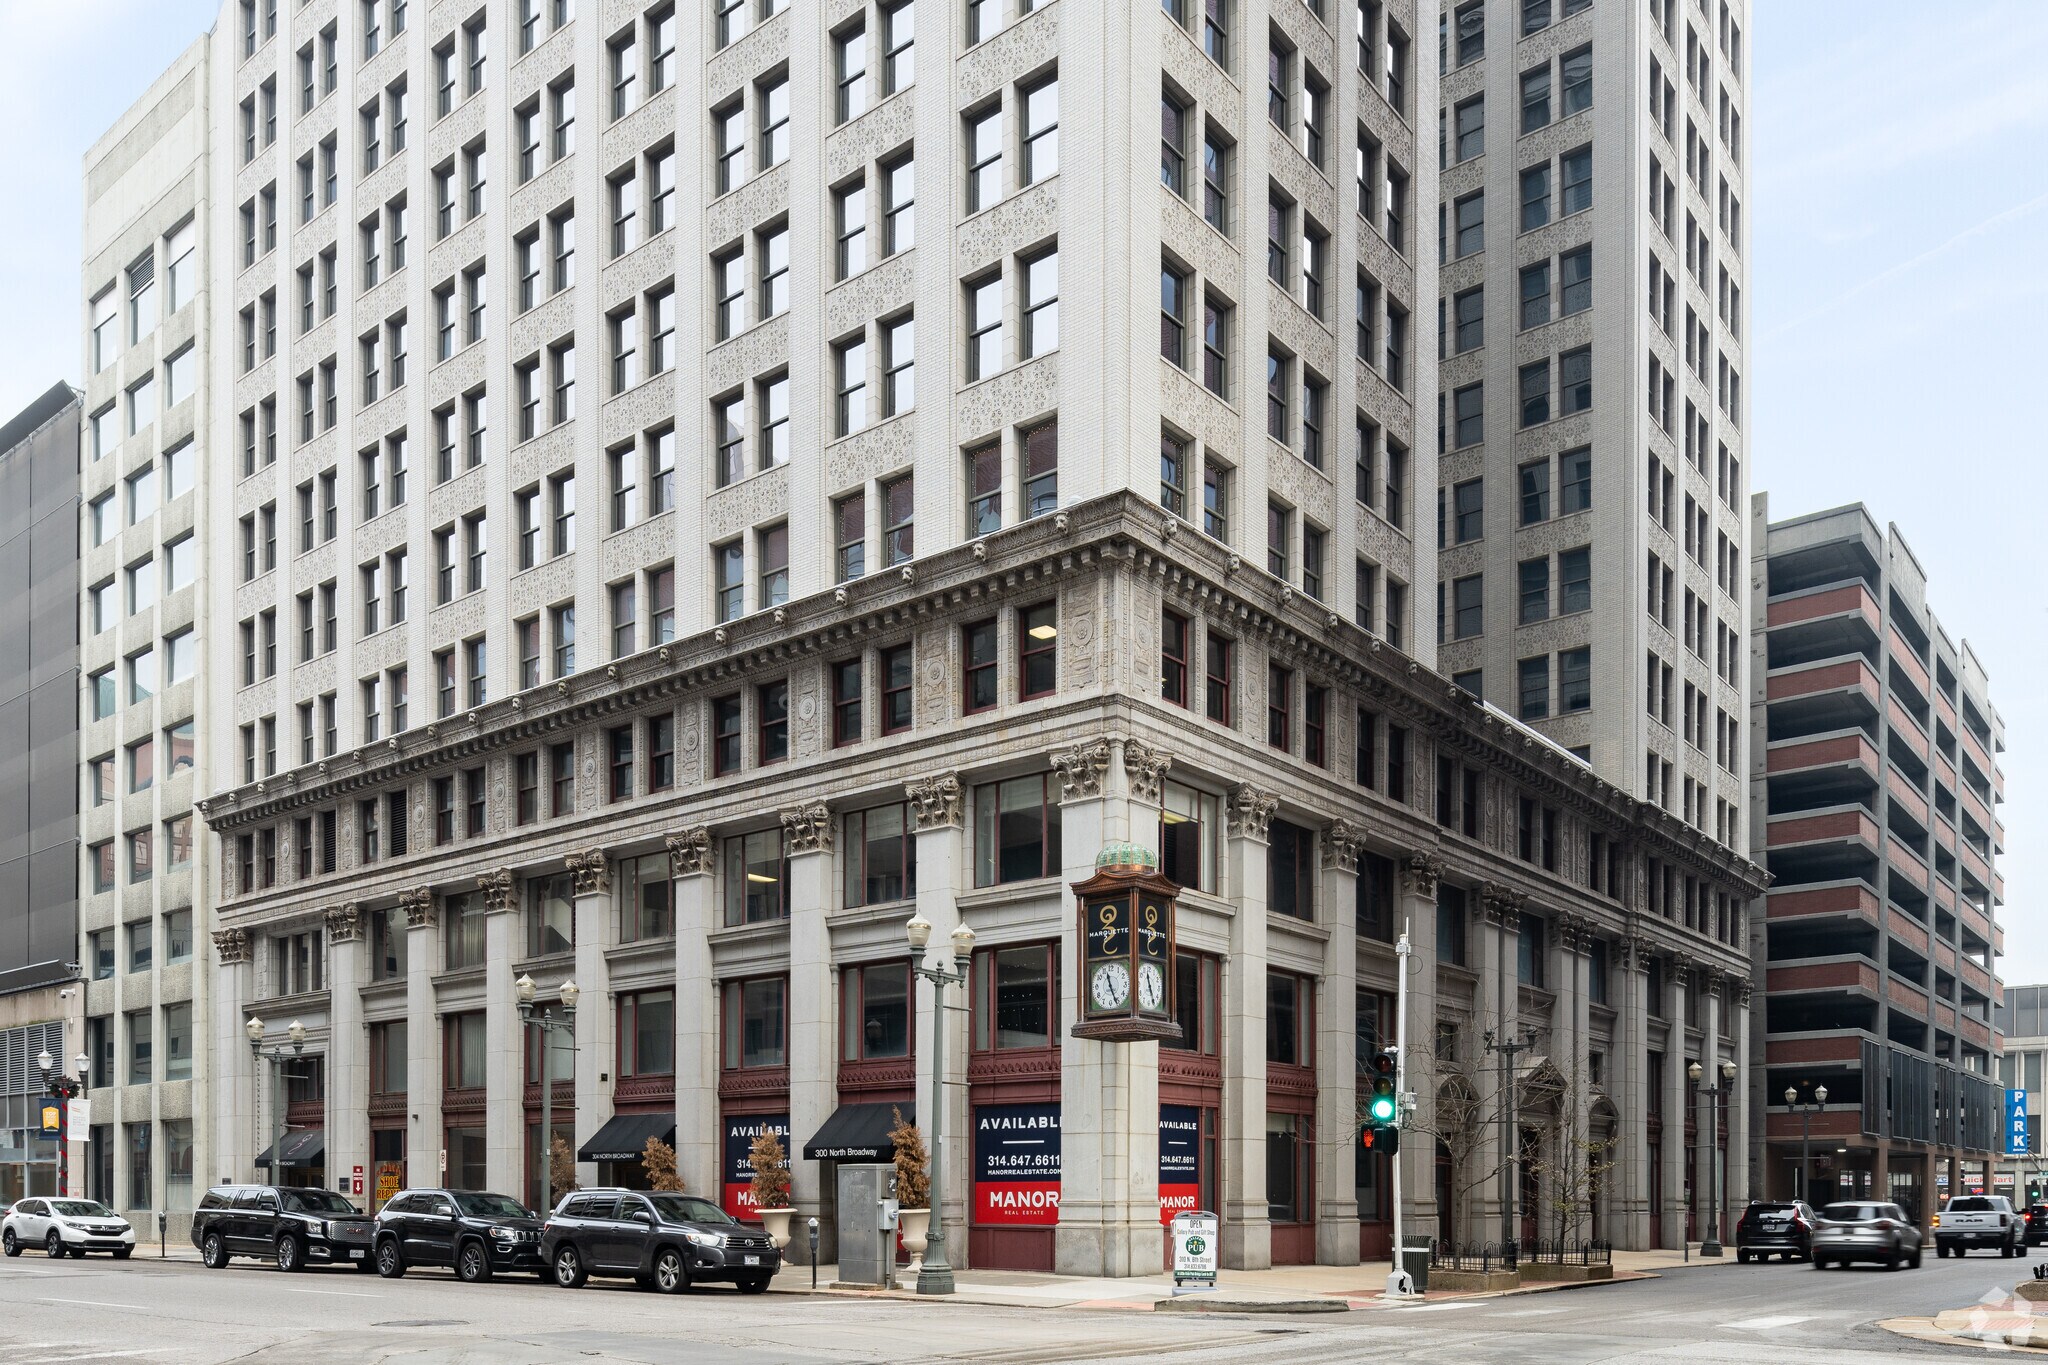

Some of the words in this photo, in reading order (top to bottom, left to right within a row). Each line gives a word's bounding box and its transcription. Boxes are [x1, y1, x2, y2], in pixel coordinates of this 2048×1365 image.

[1089, 927, 1129, 938] MARQUETTE
[981, 1117, 1062, 1130] AVAILABL
[2014, 1091, 2025, 1147] PARK
[1160, 1121, 1197, 1130] AVAILABLE
[815, 1149, 828, 1157] 300
[848, 1148, 877, 1157] Broadway
[988, 1155, 1060, 1166] 314.647.6611
[1161, 1156, 1195, 1164] 314.647.6611
[380, 1176, 398, 1187] SHOE
[990, 1191, 1059, 1208] MANOR
[1160, 1196, 1195, 1208] MANOR
[1190, 1220, 1202, 1228] OPEN
